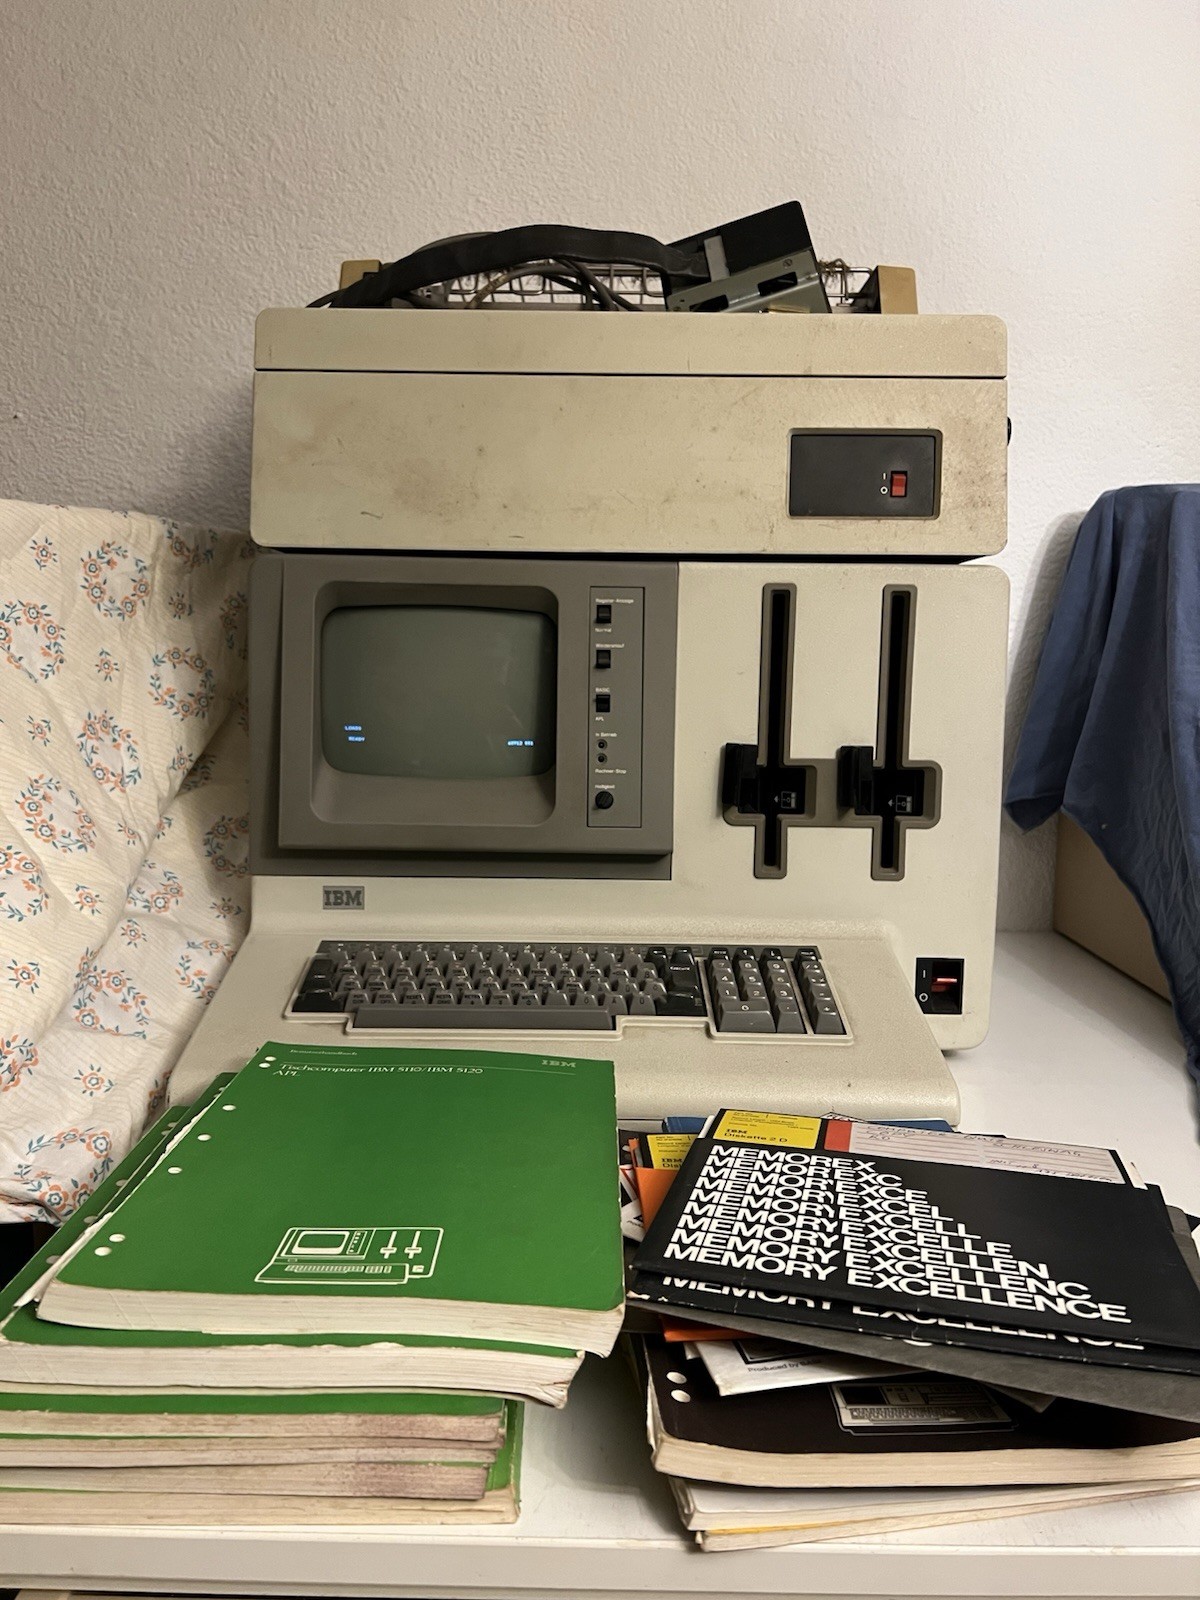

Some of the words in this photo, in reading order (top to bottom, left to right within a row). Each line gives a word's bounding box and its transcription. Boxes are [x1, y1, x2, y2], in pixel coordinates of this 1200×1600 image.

[324, 889, 362, 906] IBM
[280, 1063, 366, 1073] Tischcomputer
[542, 1059, 576, 1068] IBM
[724, 1132, 766, 1141] Diskette
[710, 1145, 876, 1173] MEMOREX
[683, 1201, 838, 1233] MEMORY
[841, 1220, 1014, 1259] EXCELLE
[677, 1214, 839, 1248] MEMORY
[843, 1236, 1050, 1279] EXCELLEN
[671, 1228, 840, 1264] MEMORY
[845, 1252, 1091, 1300] EXCELLENC
[664, 1243, 838, 1281] MEMORY
[847, 1268, 1132, 1323] EXCELLENCE
